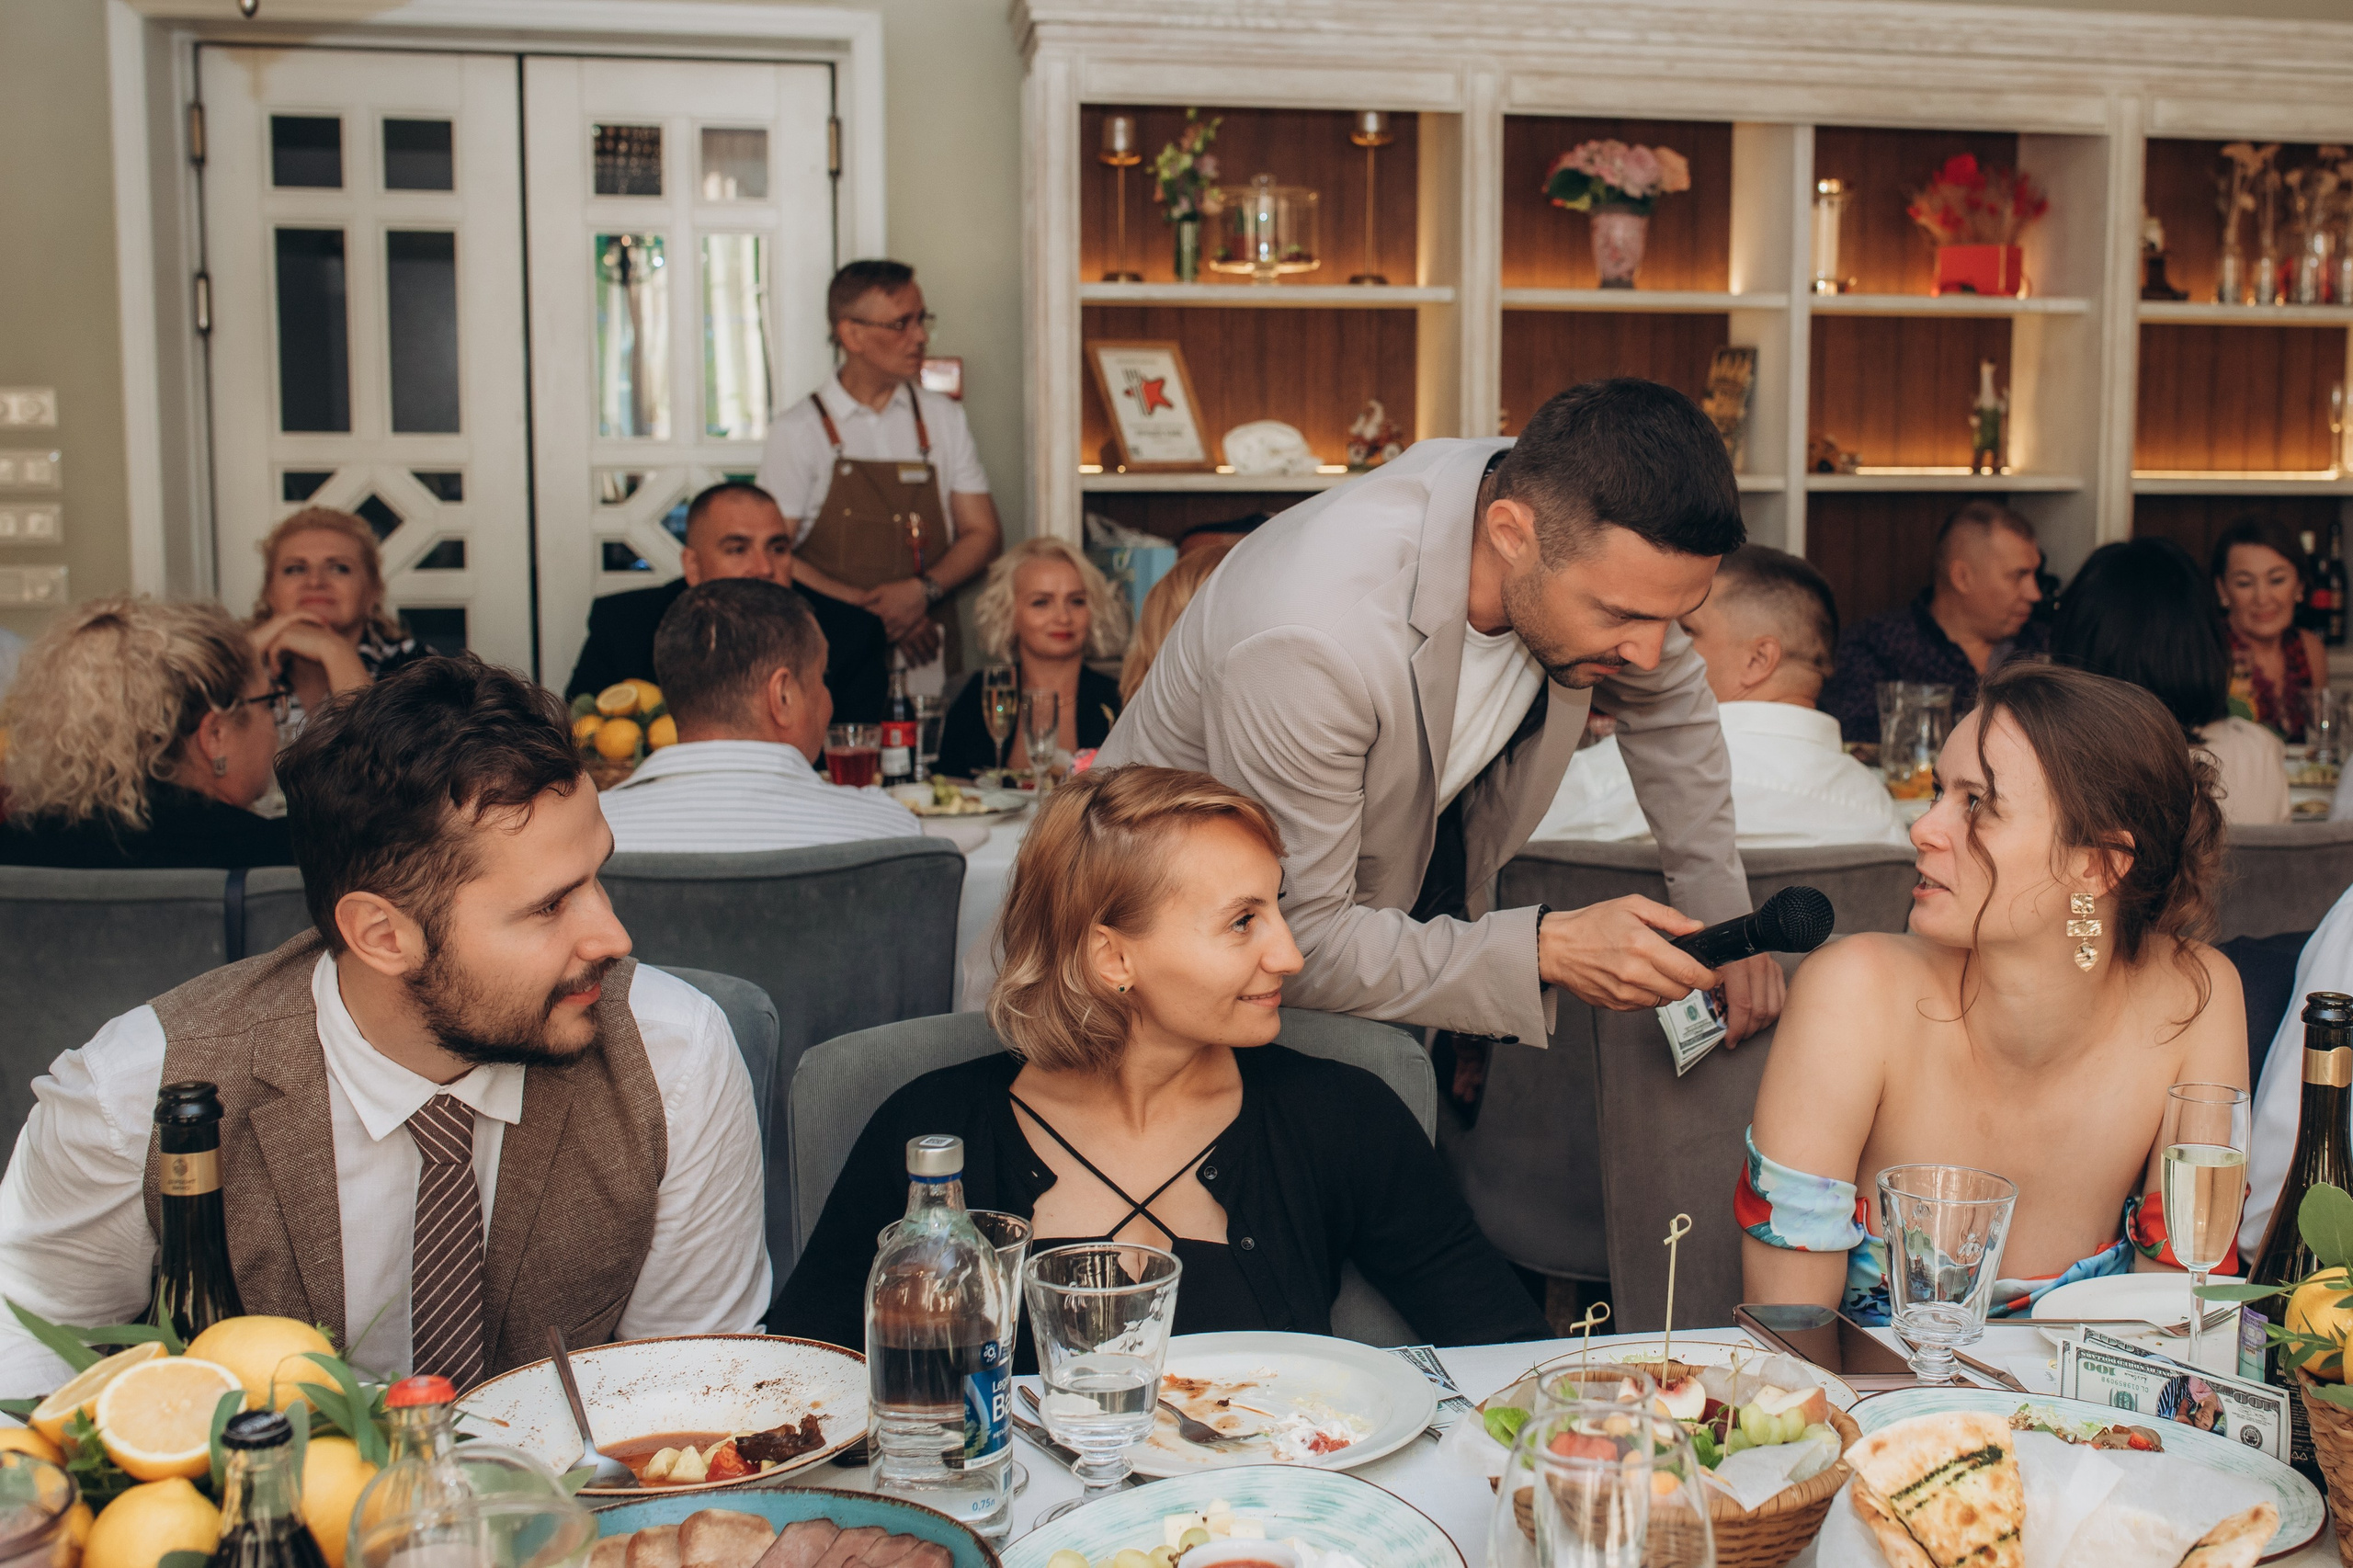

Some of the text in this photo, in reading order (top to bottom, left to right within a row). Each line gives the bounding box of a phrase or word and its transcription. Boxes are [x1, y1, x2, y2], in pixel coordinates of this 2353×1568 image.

[2083, 1361, 2116, 1376] 100
[2234, 1392, 2272, 1412] 100
[972, 1497, 995, 1512] 0,75л
